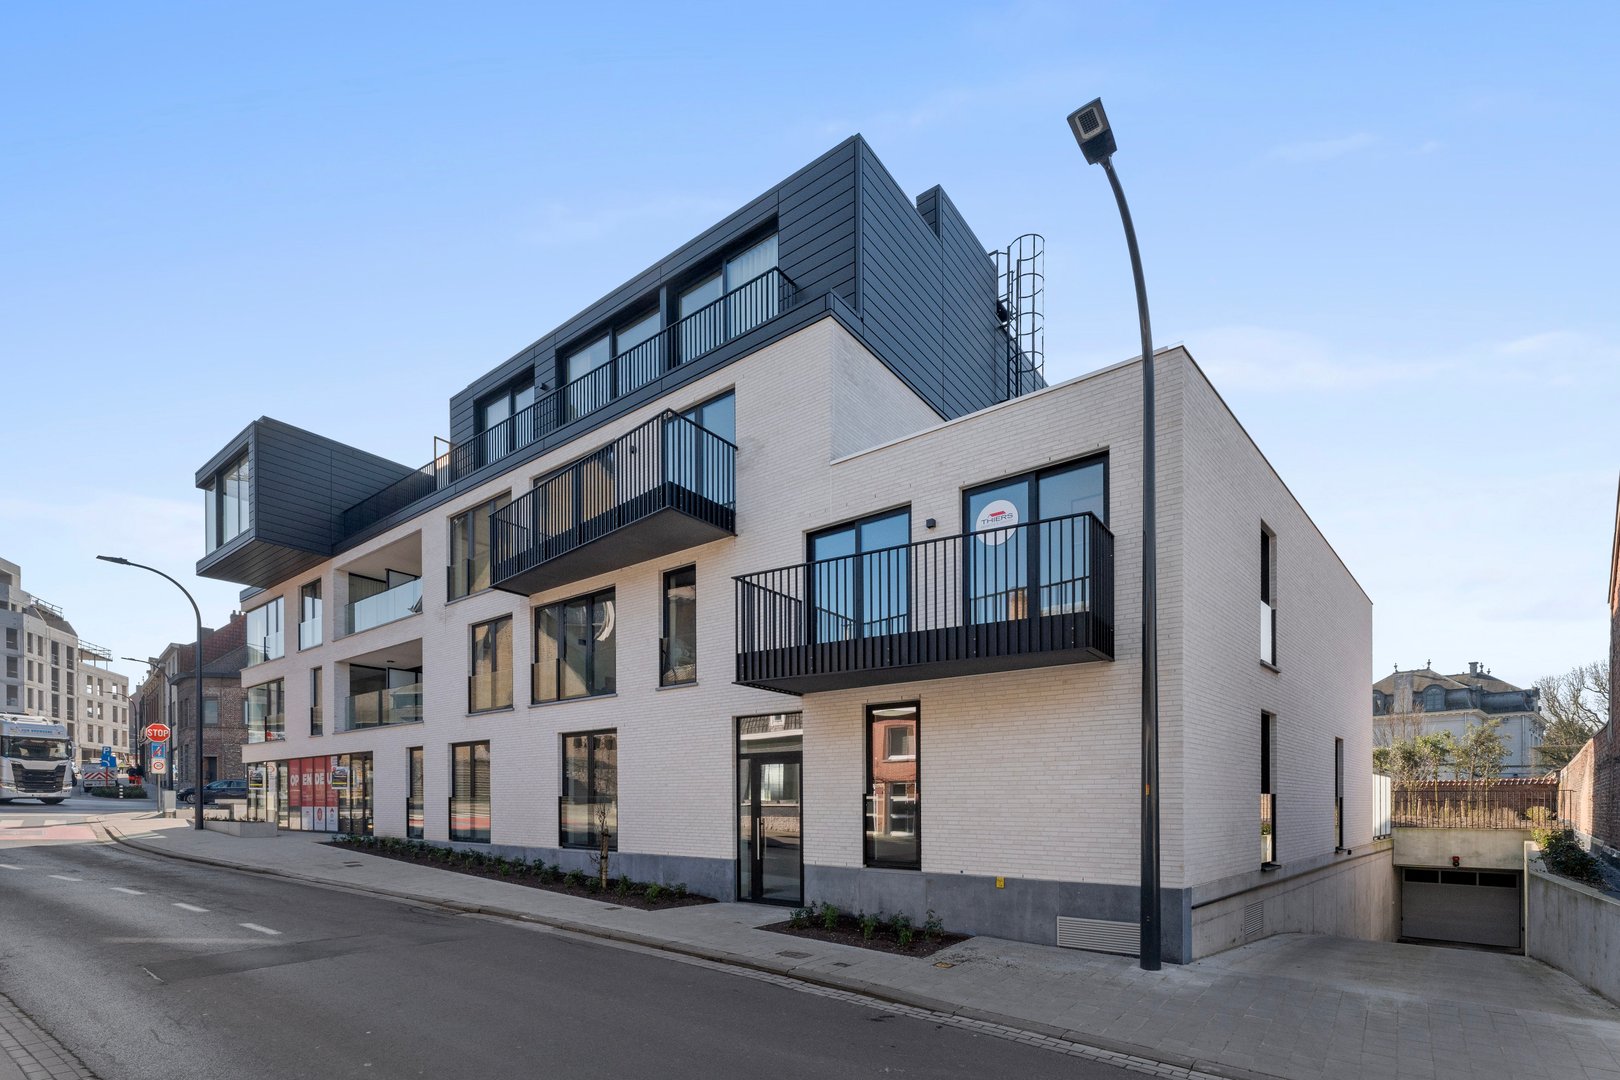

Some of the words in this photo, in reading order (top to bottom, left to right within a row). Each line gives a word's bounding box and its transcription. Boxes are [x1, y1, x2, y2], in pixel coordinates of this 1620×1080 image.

[981, 512, 1014, 525] THIERS
[147, 729, 169, 737] STOP
[103, 747, 110, 755] P
